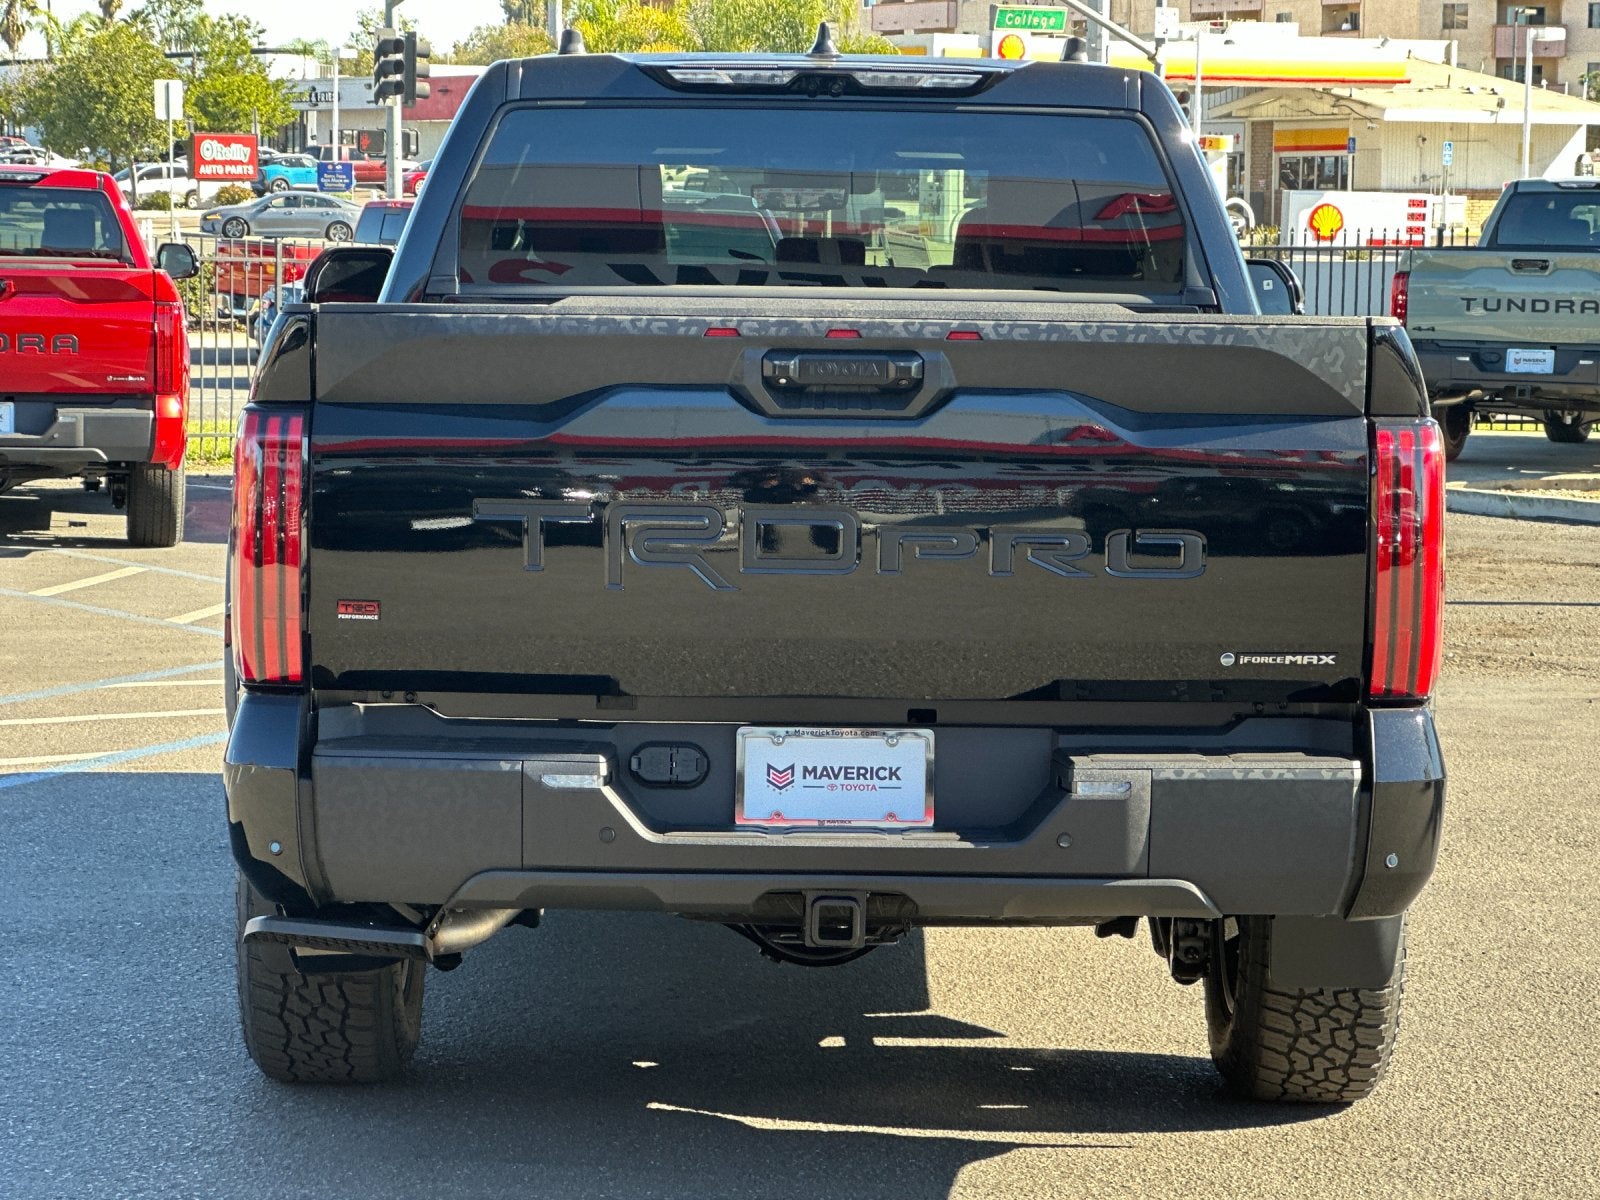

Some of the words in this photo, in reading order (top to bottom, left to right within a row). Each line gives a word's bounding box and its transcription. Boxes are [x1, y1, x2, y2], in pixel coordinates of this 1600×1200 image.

[1005, 12, 1056, 29] College
[201, 140, 250, 163] O'Reilly
[200, 164, 224, 175] AUTO
[225, 164, 254, 175] PARTS
[1460, 297, 1600, 314] TUNDRA
[806, 361, 881, 378] TOYOTA
[793, 729, 879, 737] MaverickToyota.com
[802, 765, 902, 781] MAVERICK
[840, 783, 878, 792] TOYOTA
